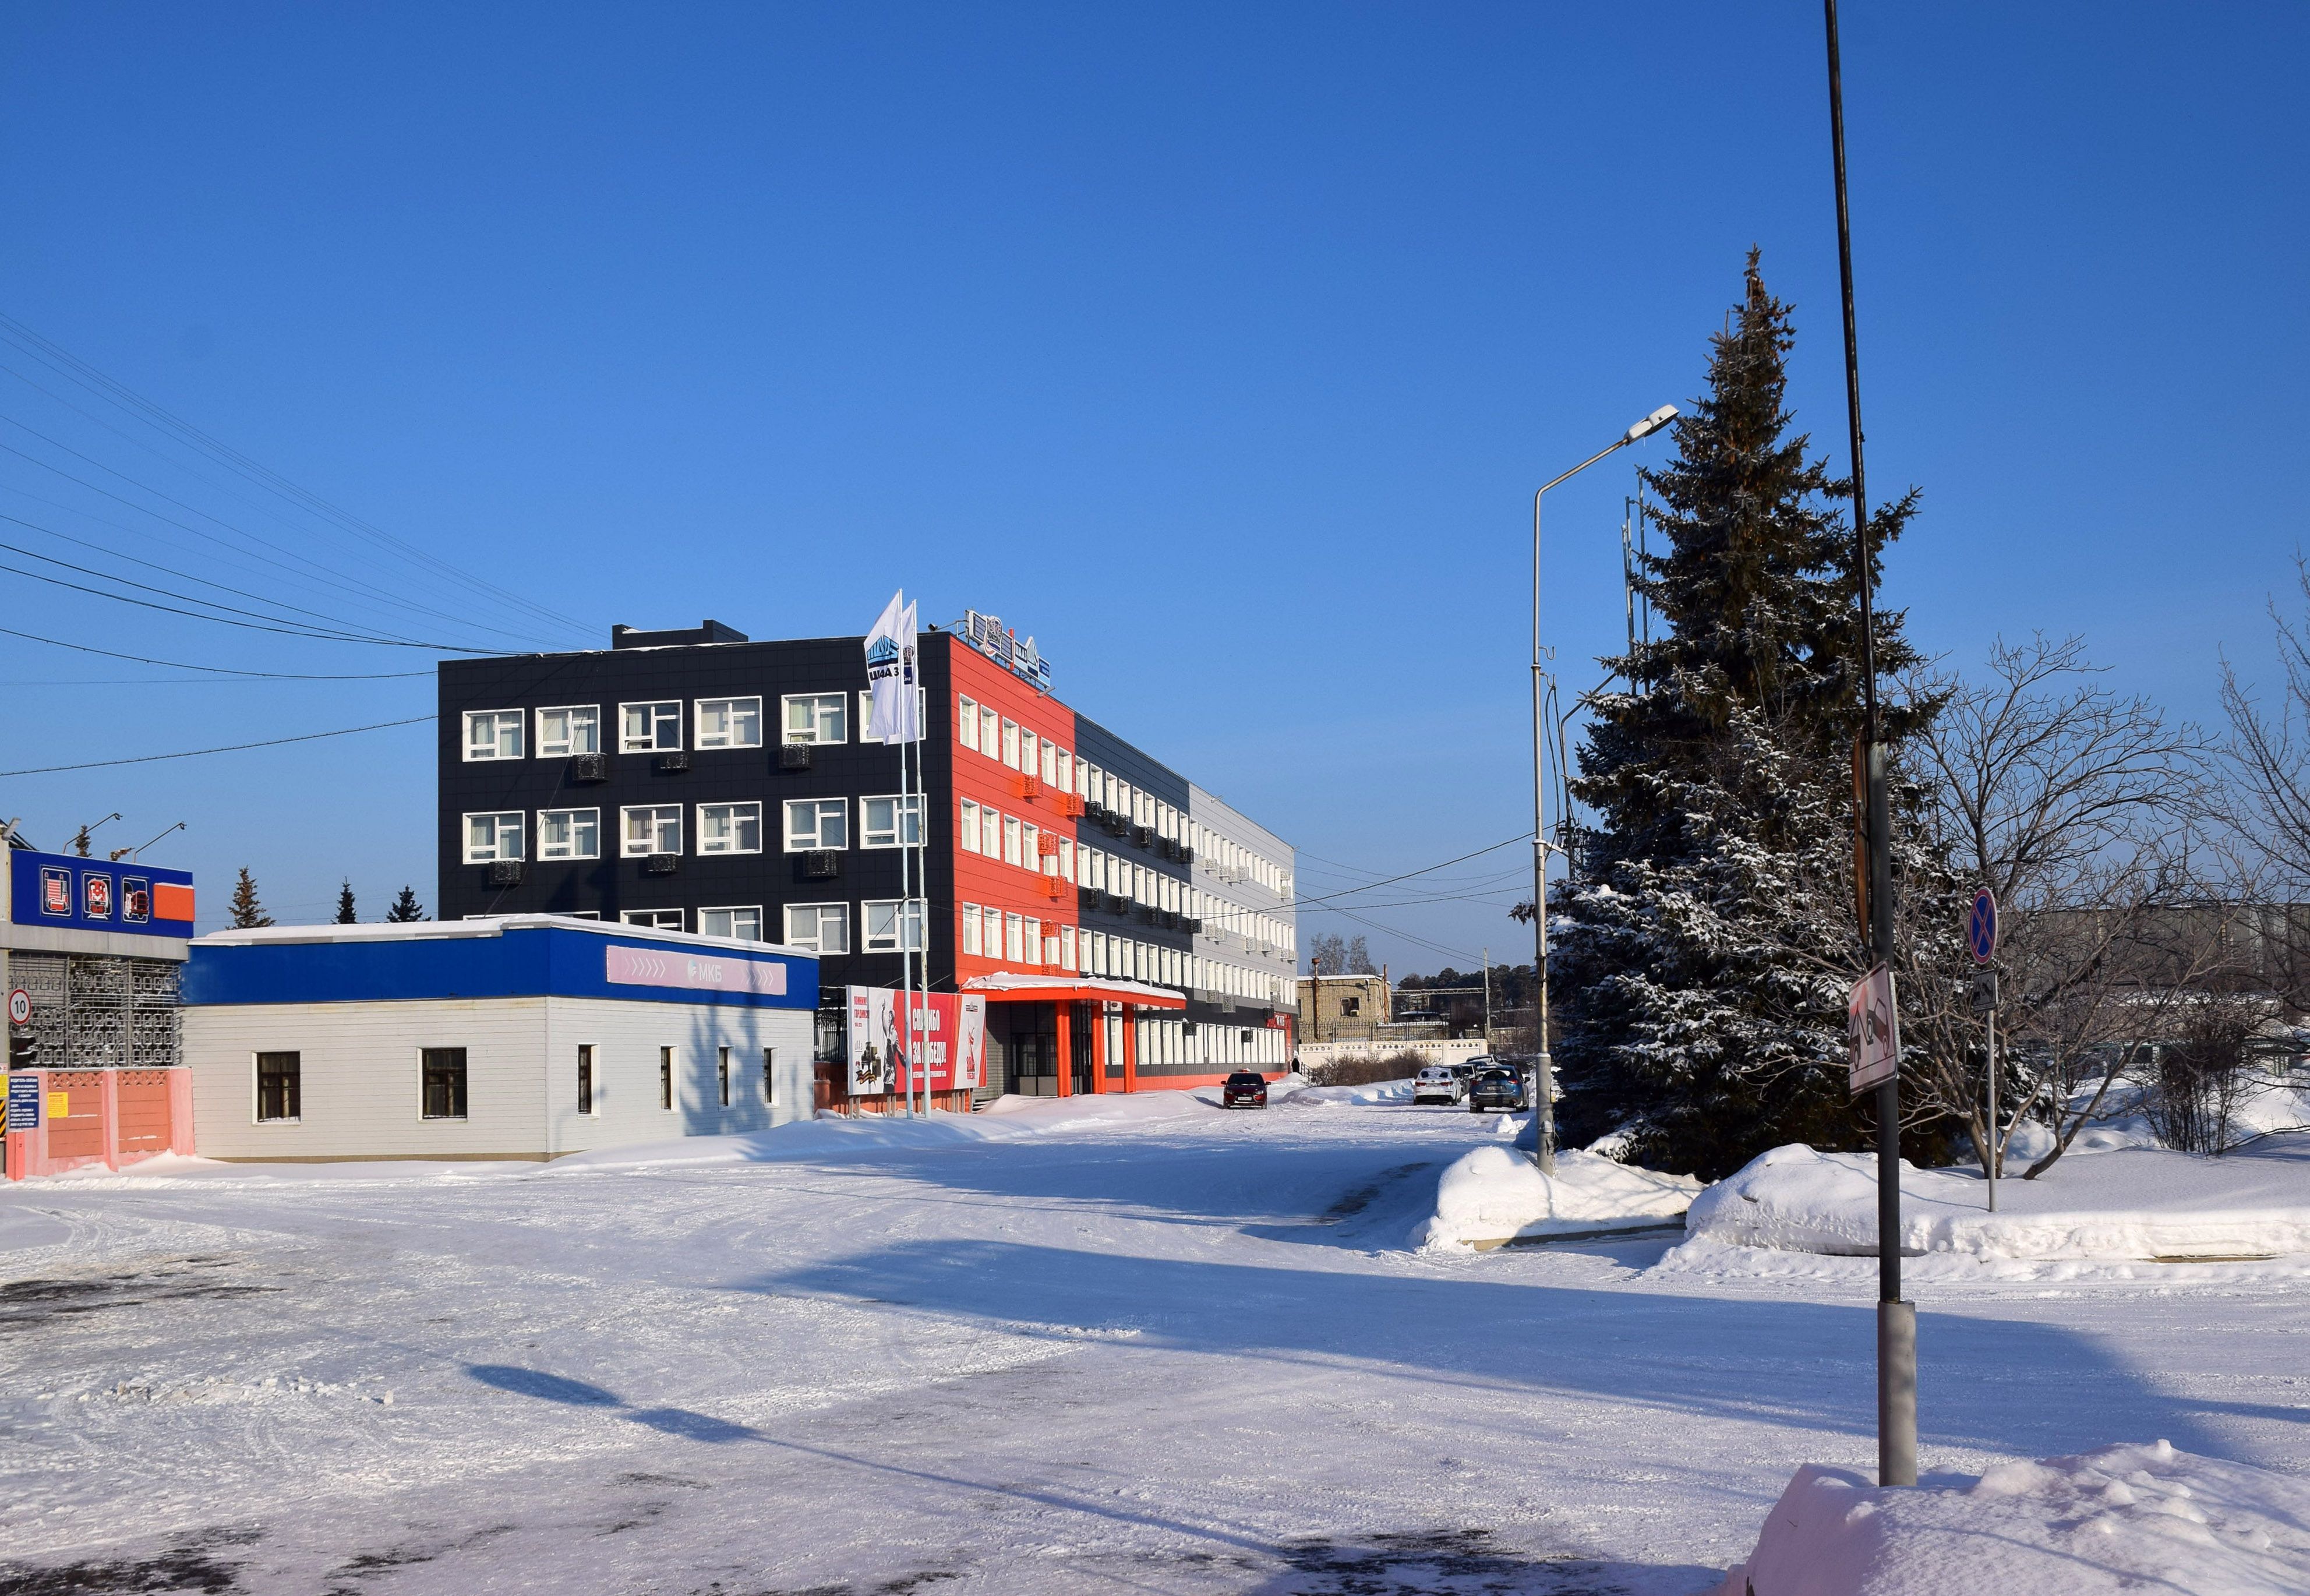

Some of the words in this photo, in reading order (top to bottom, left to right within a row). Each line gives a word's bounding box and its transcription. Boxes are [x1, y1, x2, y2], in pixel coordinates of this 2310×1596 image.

[699, 963, 722, 983] МКБ
[15, 1000, 26, 1014] 10
[913, 1008, 940, 1031] СПИБО
[913, 1041, 921, 1064] ЗА
[922, 1041, 946, 1067] БЕДУ!
